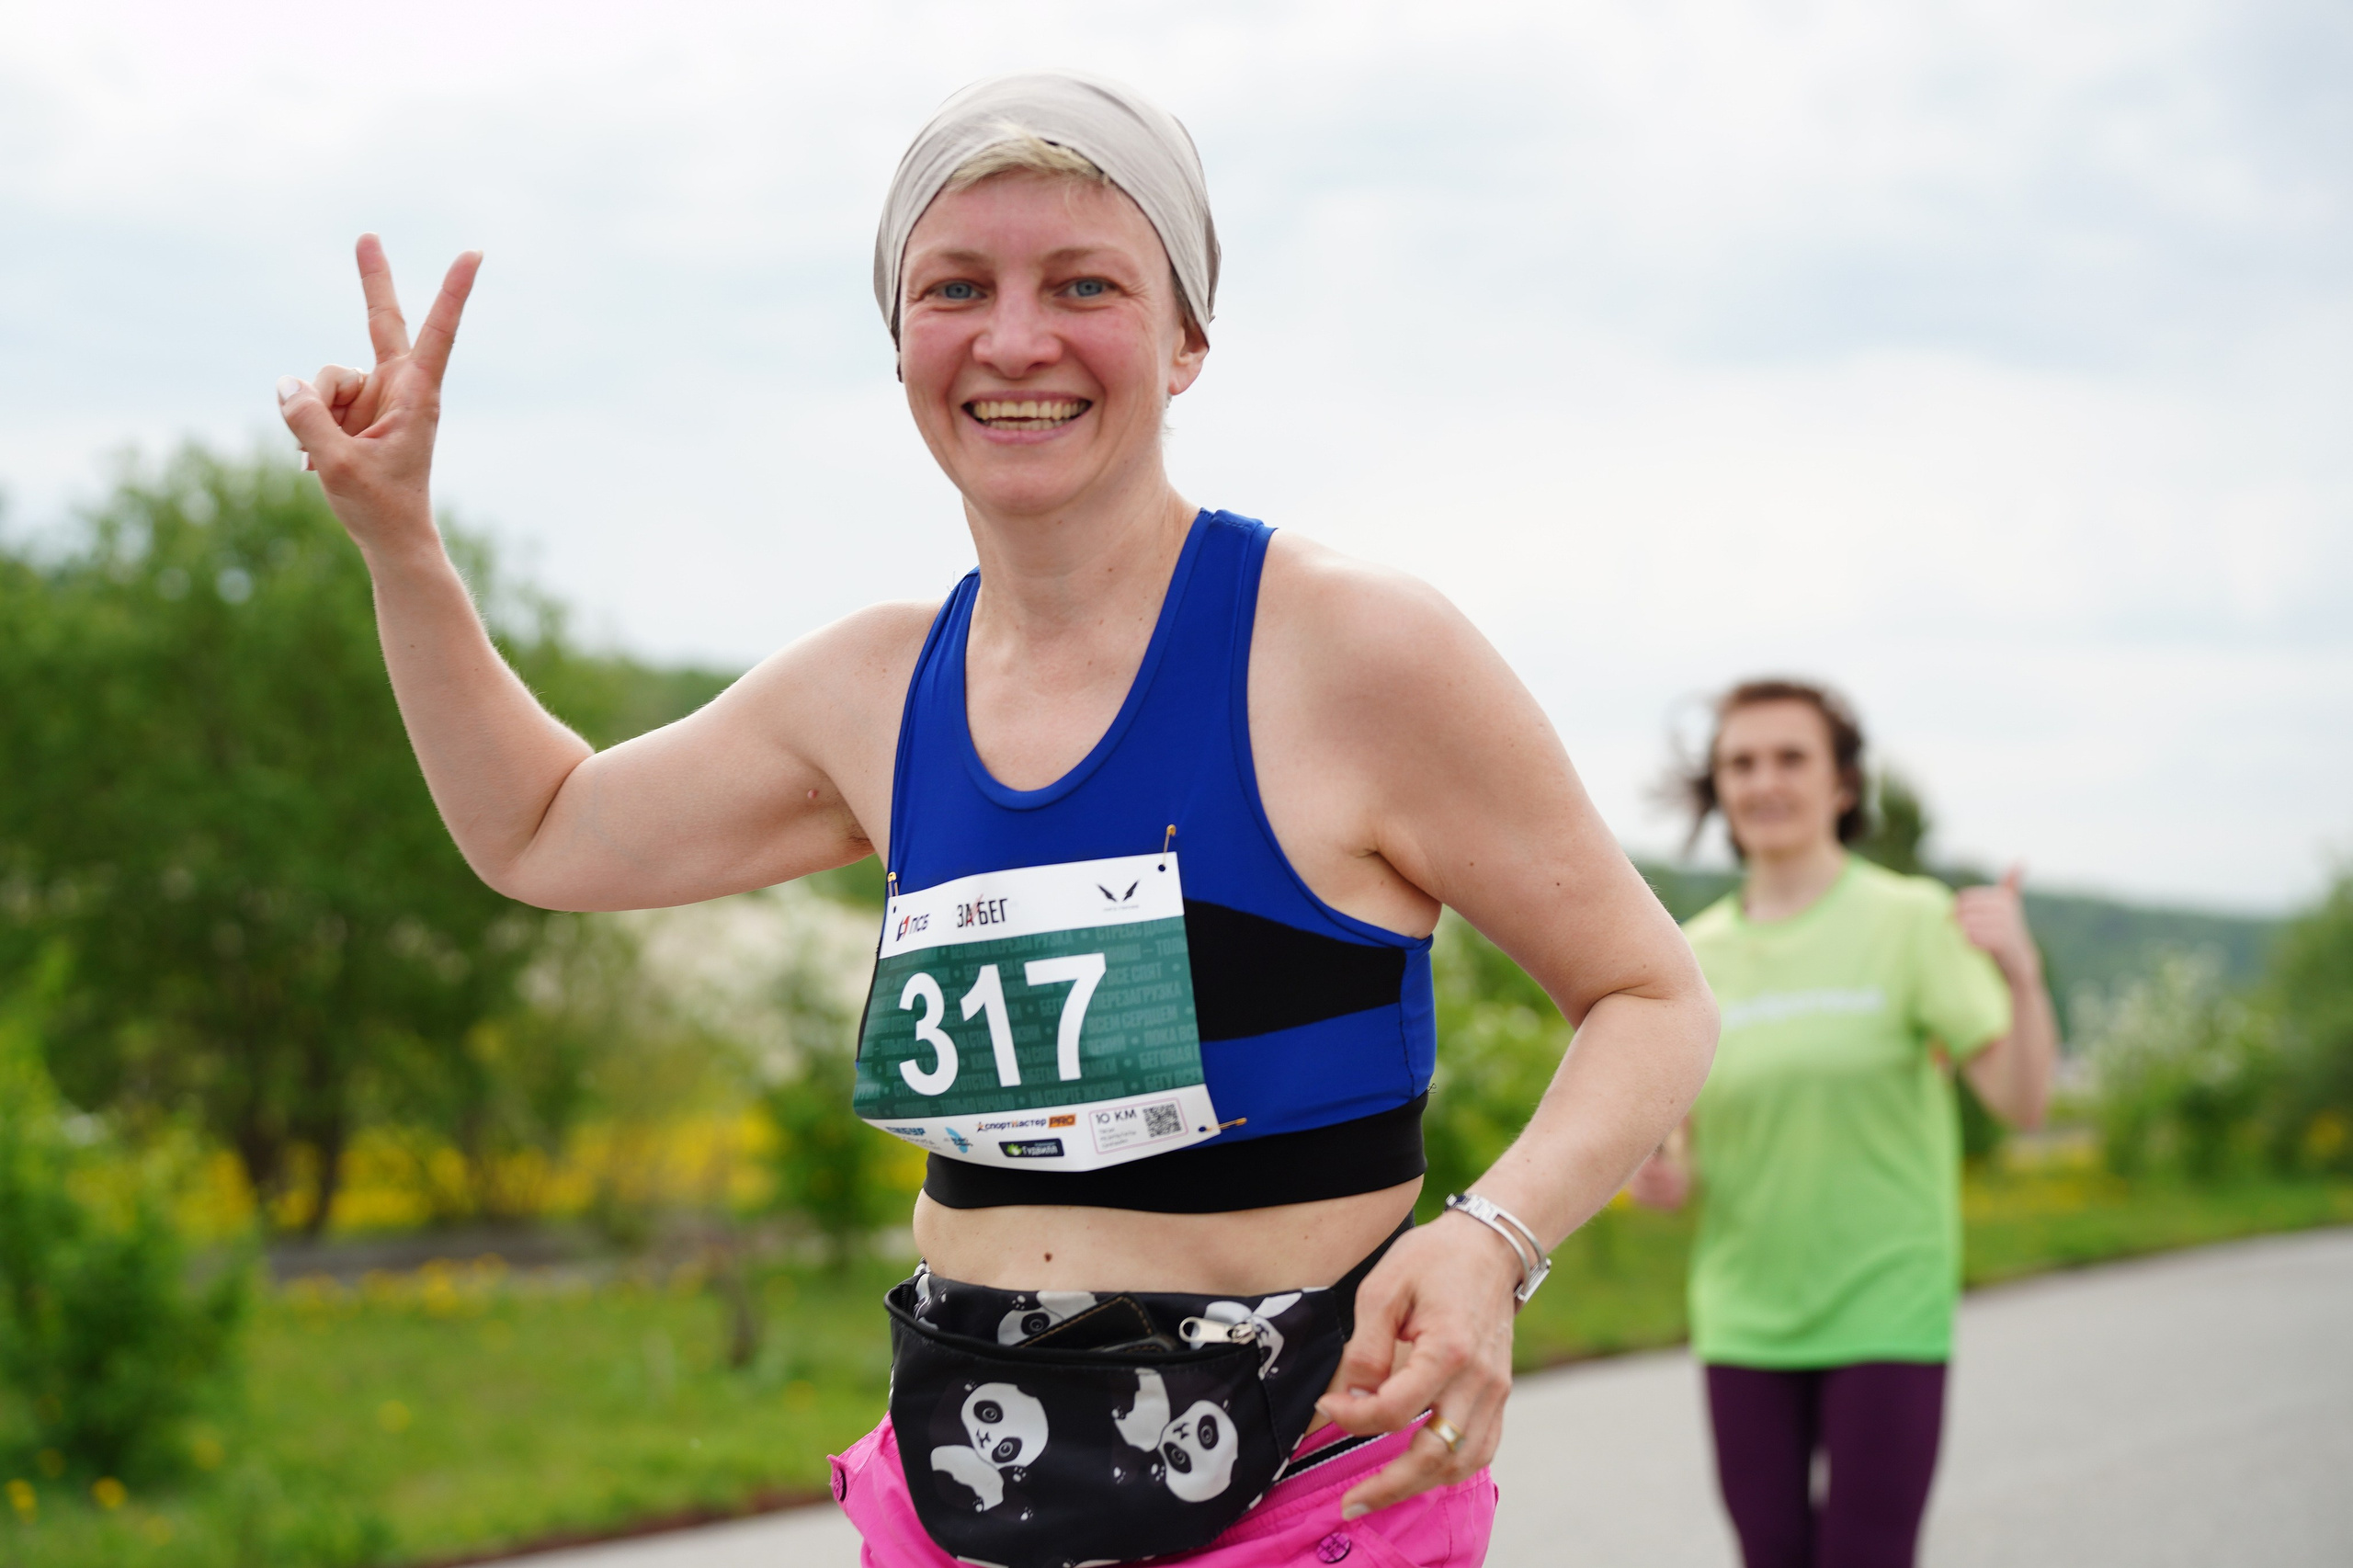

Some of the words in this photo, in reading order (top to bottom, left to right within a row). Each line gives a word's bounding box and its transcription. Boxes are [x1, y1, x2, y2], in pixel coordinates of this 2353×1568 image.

[908, 913, 930, 935] ПСБ
[899, 952, 1106, 1096] 317
[1097, 1112, 1110, 1124] 10
